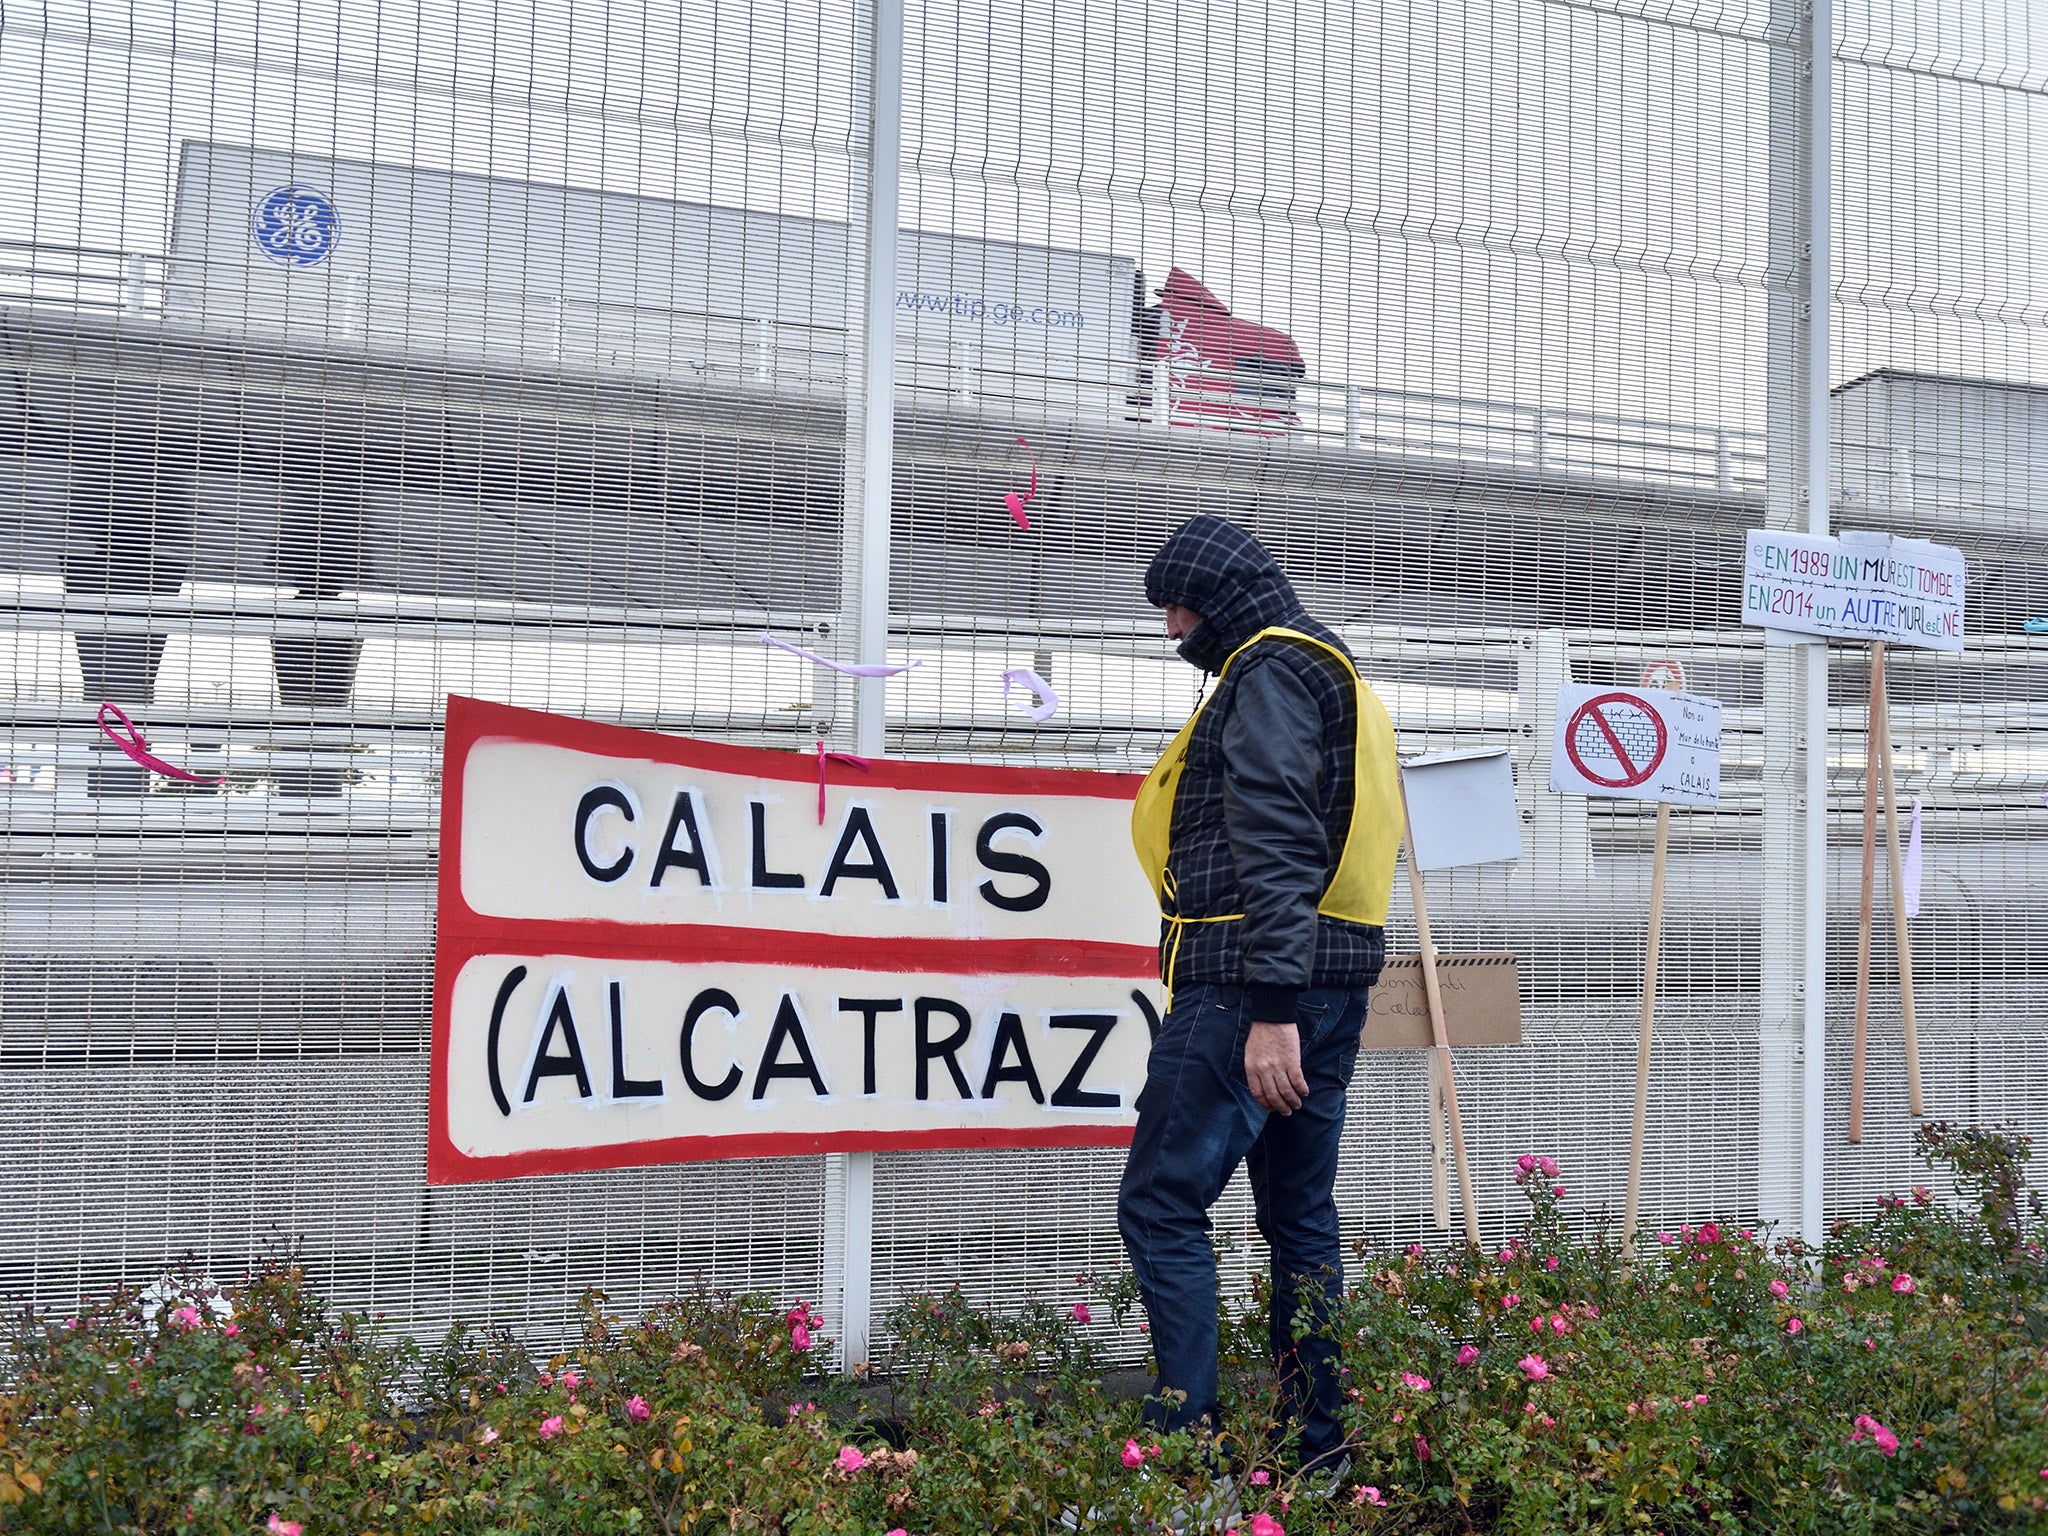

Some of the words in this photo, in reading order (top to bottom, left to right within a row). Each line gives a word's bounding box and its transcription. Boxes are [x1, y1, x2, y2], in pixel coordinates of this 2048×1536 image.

[896, 291, 1085, 328] ww.tip.ge.com
[1765, 545, 1789, 572] EN
[1790, 548, 1830, 577] 1989
[1832, 555, 1858, 581] UN
[1897, 562, 1916, 589] EST
[1917, 567, 1953, 598] TOMBE
[1748, 584, 1771, 612] EN
[1771, 588, 1814, 618] 2014
[1816, 605, 1836, 621] un
[1841, 597, 1896, 627] AUTRE
[1942, 609, 1960, 637] NÉ
[1683, 707, 1695, 720] Non
[1680, 772, 1710, 791] CALAIS
[574, 785, 1051, 912] CALAIS
